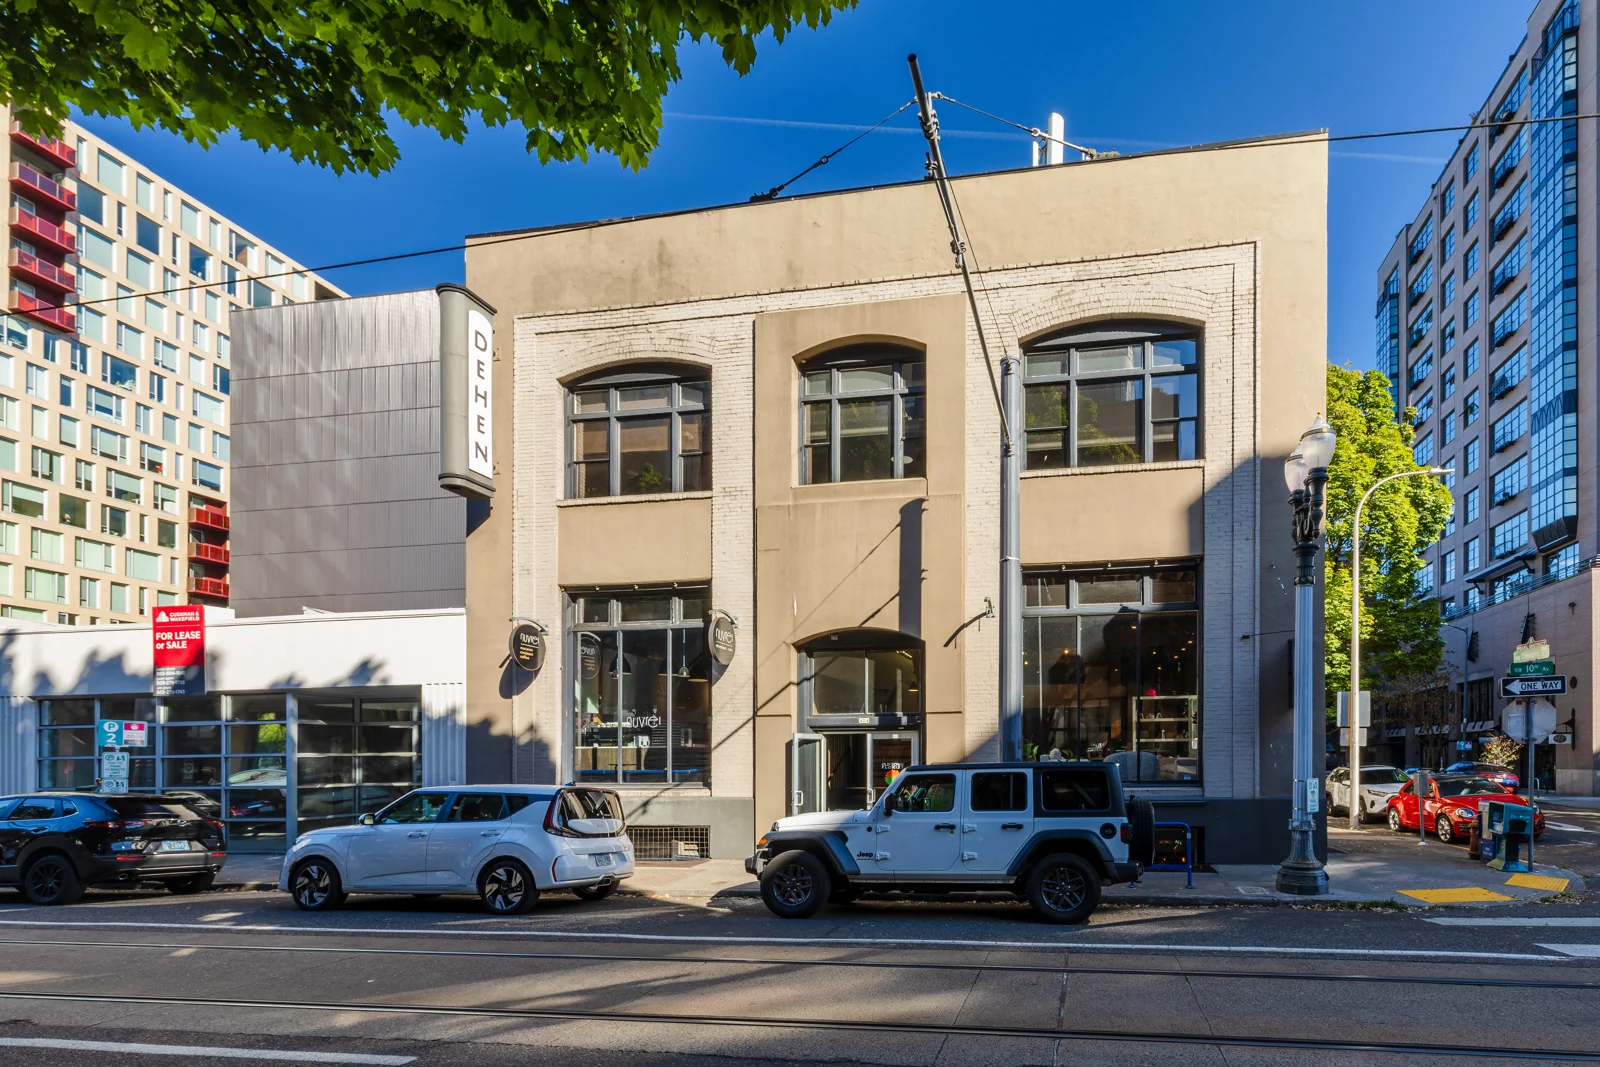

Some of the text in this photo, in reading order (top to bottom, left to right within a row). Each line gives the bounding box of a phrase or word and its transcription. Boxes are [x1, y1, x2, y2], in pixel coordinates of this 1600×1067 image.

[474, 329, 488, 464] DEHEN
[155, 630, 201, 640] FOR LEASE
[166, 640, 188, 649] SALE
[1521, 681, 1559, 690] ONE WAY
[106, 733, 117, 743] 2
